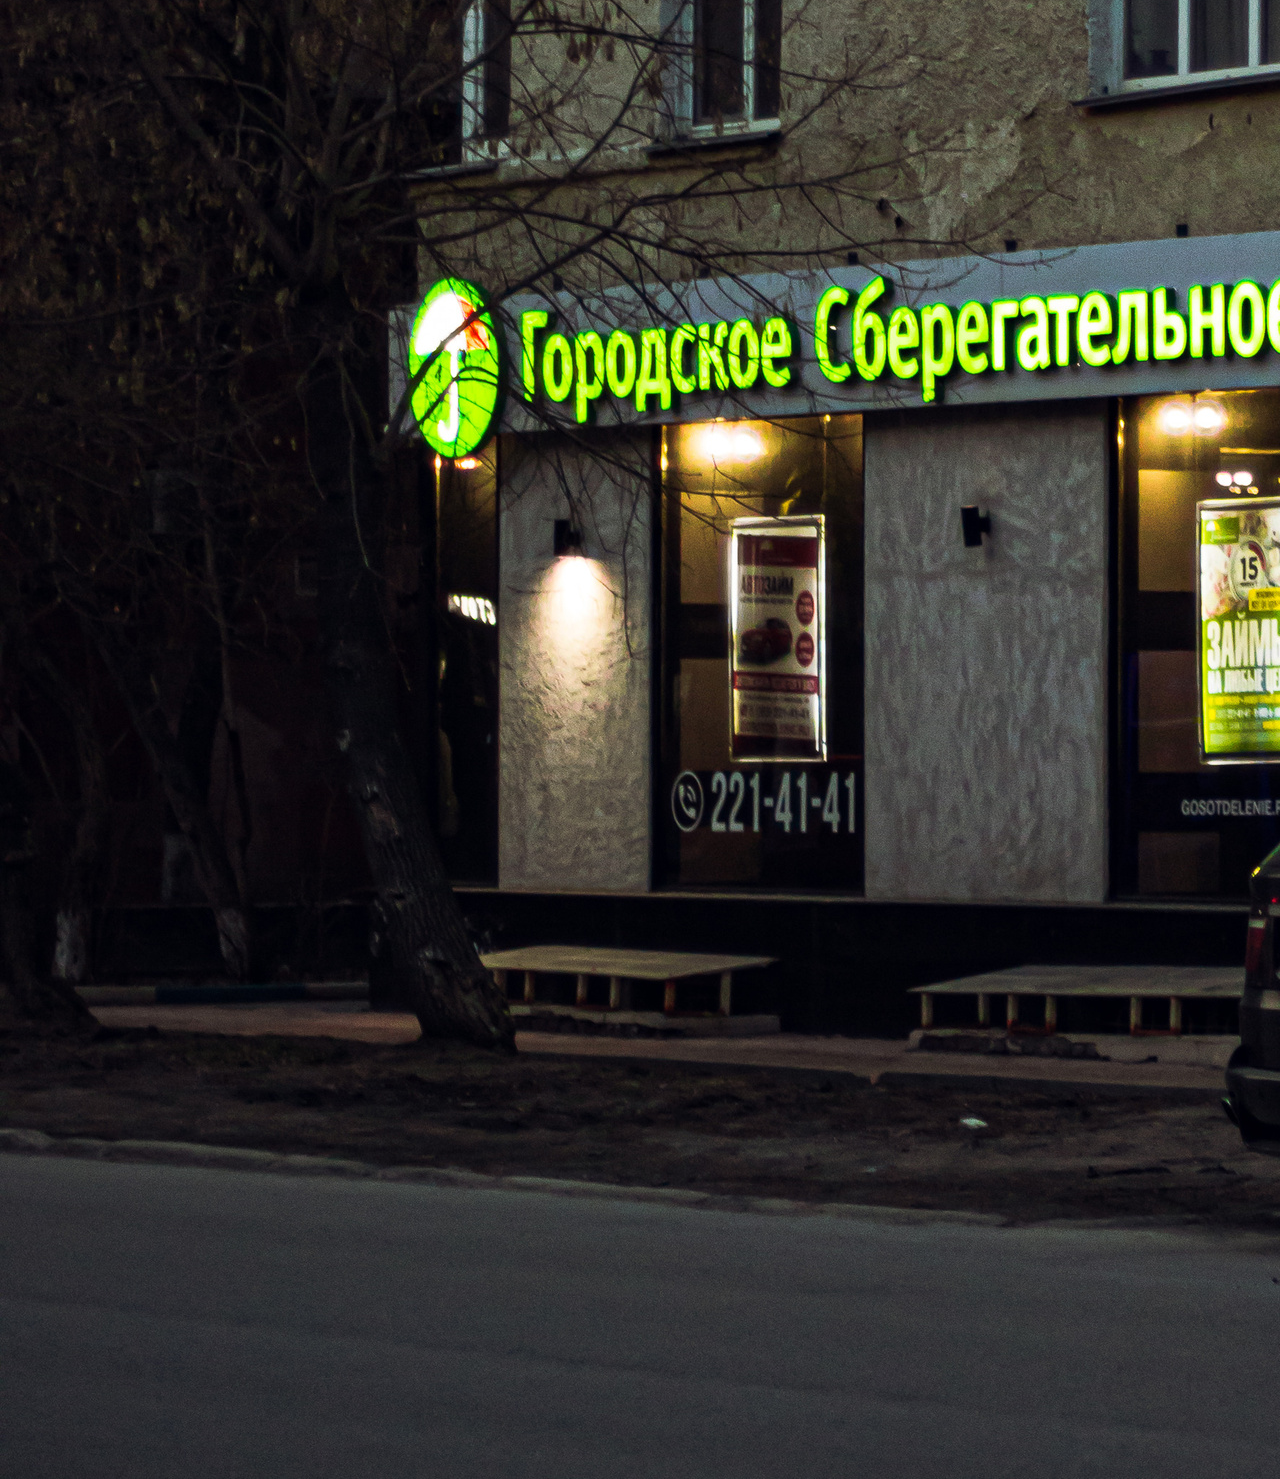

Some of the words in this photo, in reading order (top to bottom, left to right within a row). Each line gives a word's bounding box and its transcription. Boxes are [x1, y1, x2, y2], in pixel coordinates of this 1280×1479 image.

[521, 309, 793, 423] Городское
[1240, 556, 1258, 581] 15
[711, 771, 856, 834] 221-41-41
